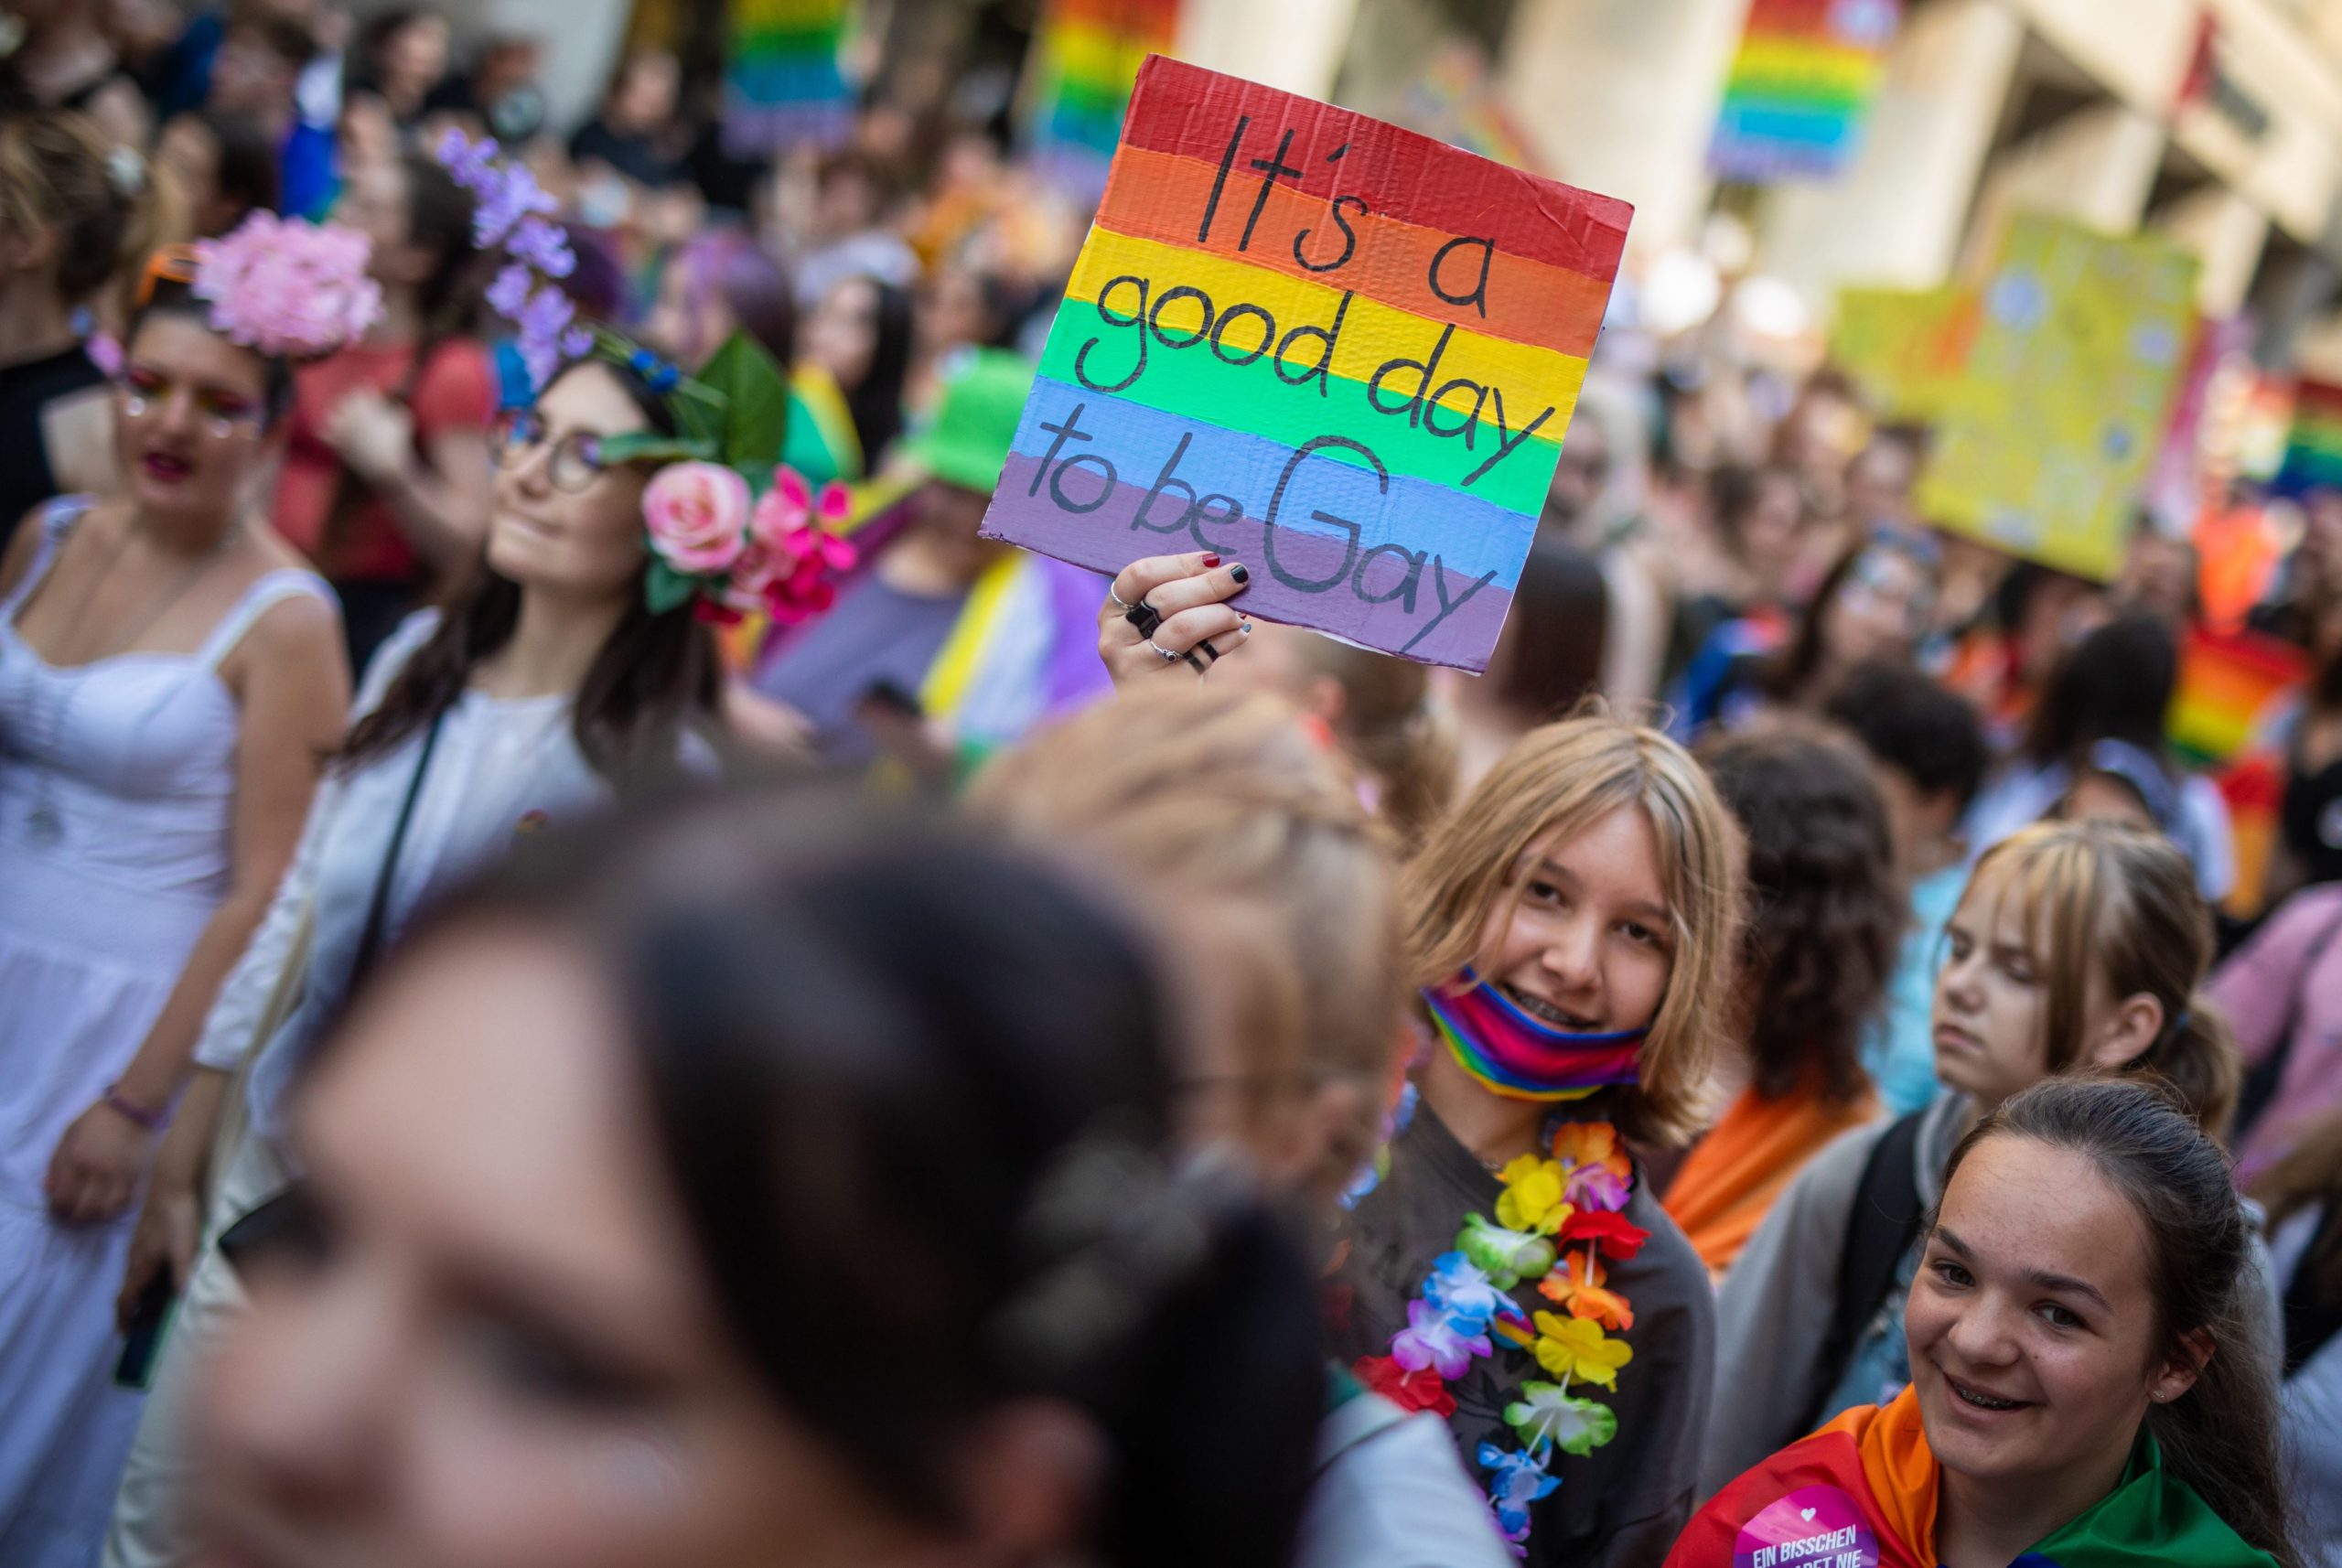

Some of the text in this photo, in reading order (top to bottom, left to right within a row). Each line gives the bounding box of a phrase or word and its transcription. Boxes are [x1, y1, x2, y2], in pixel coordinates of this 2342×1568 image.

[1197, 115, 1495, 319] It's a
[1074, 274, 1556, 487] good day
[1027, 403, 1499, 653] to be Gay
[1753, 1524, 1856, 1568] EIN BISSCHEN
[1835, 1549, 1864, 1568] NIE
